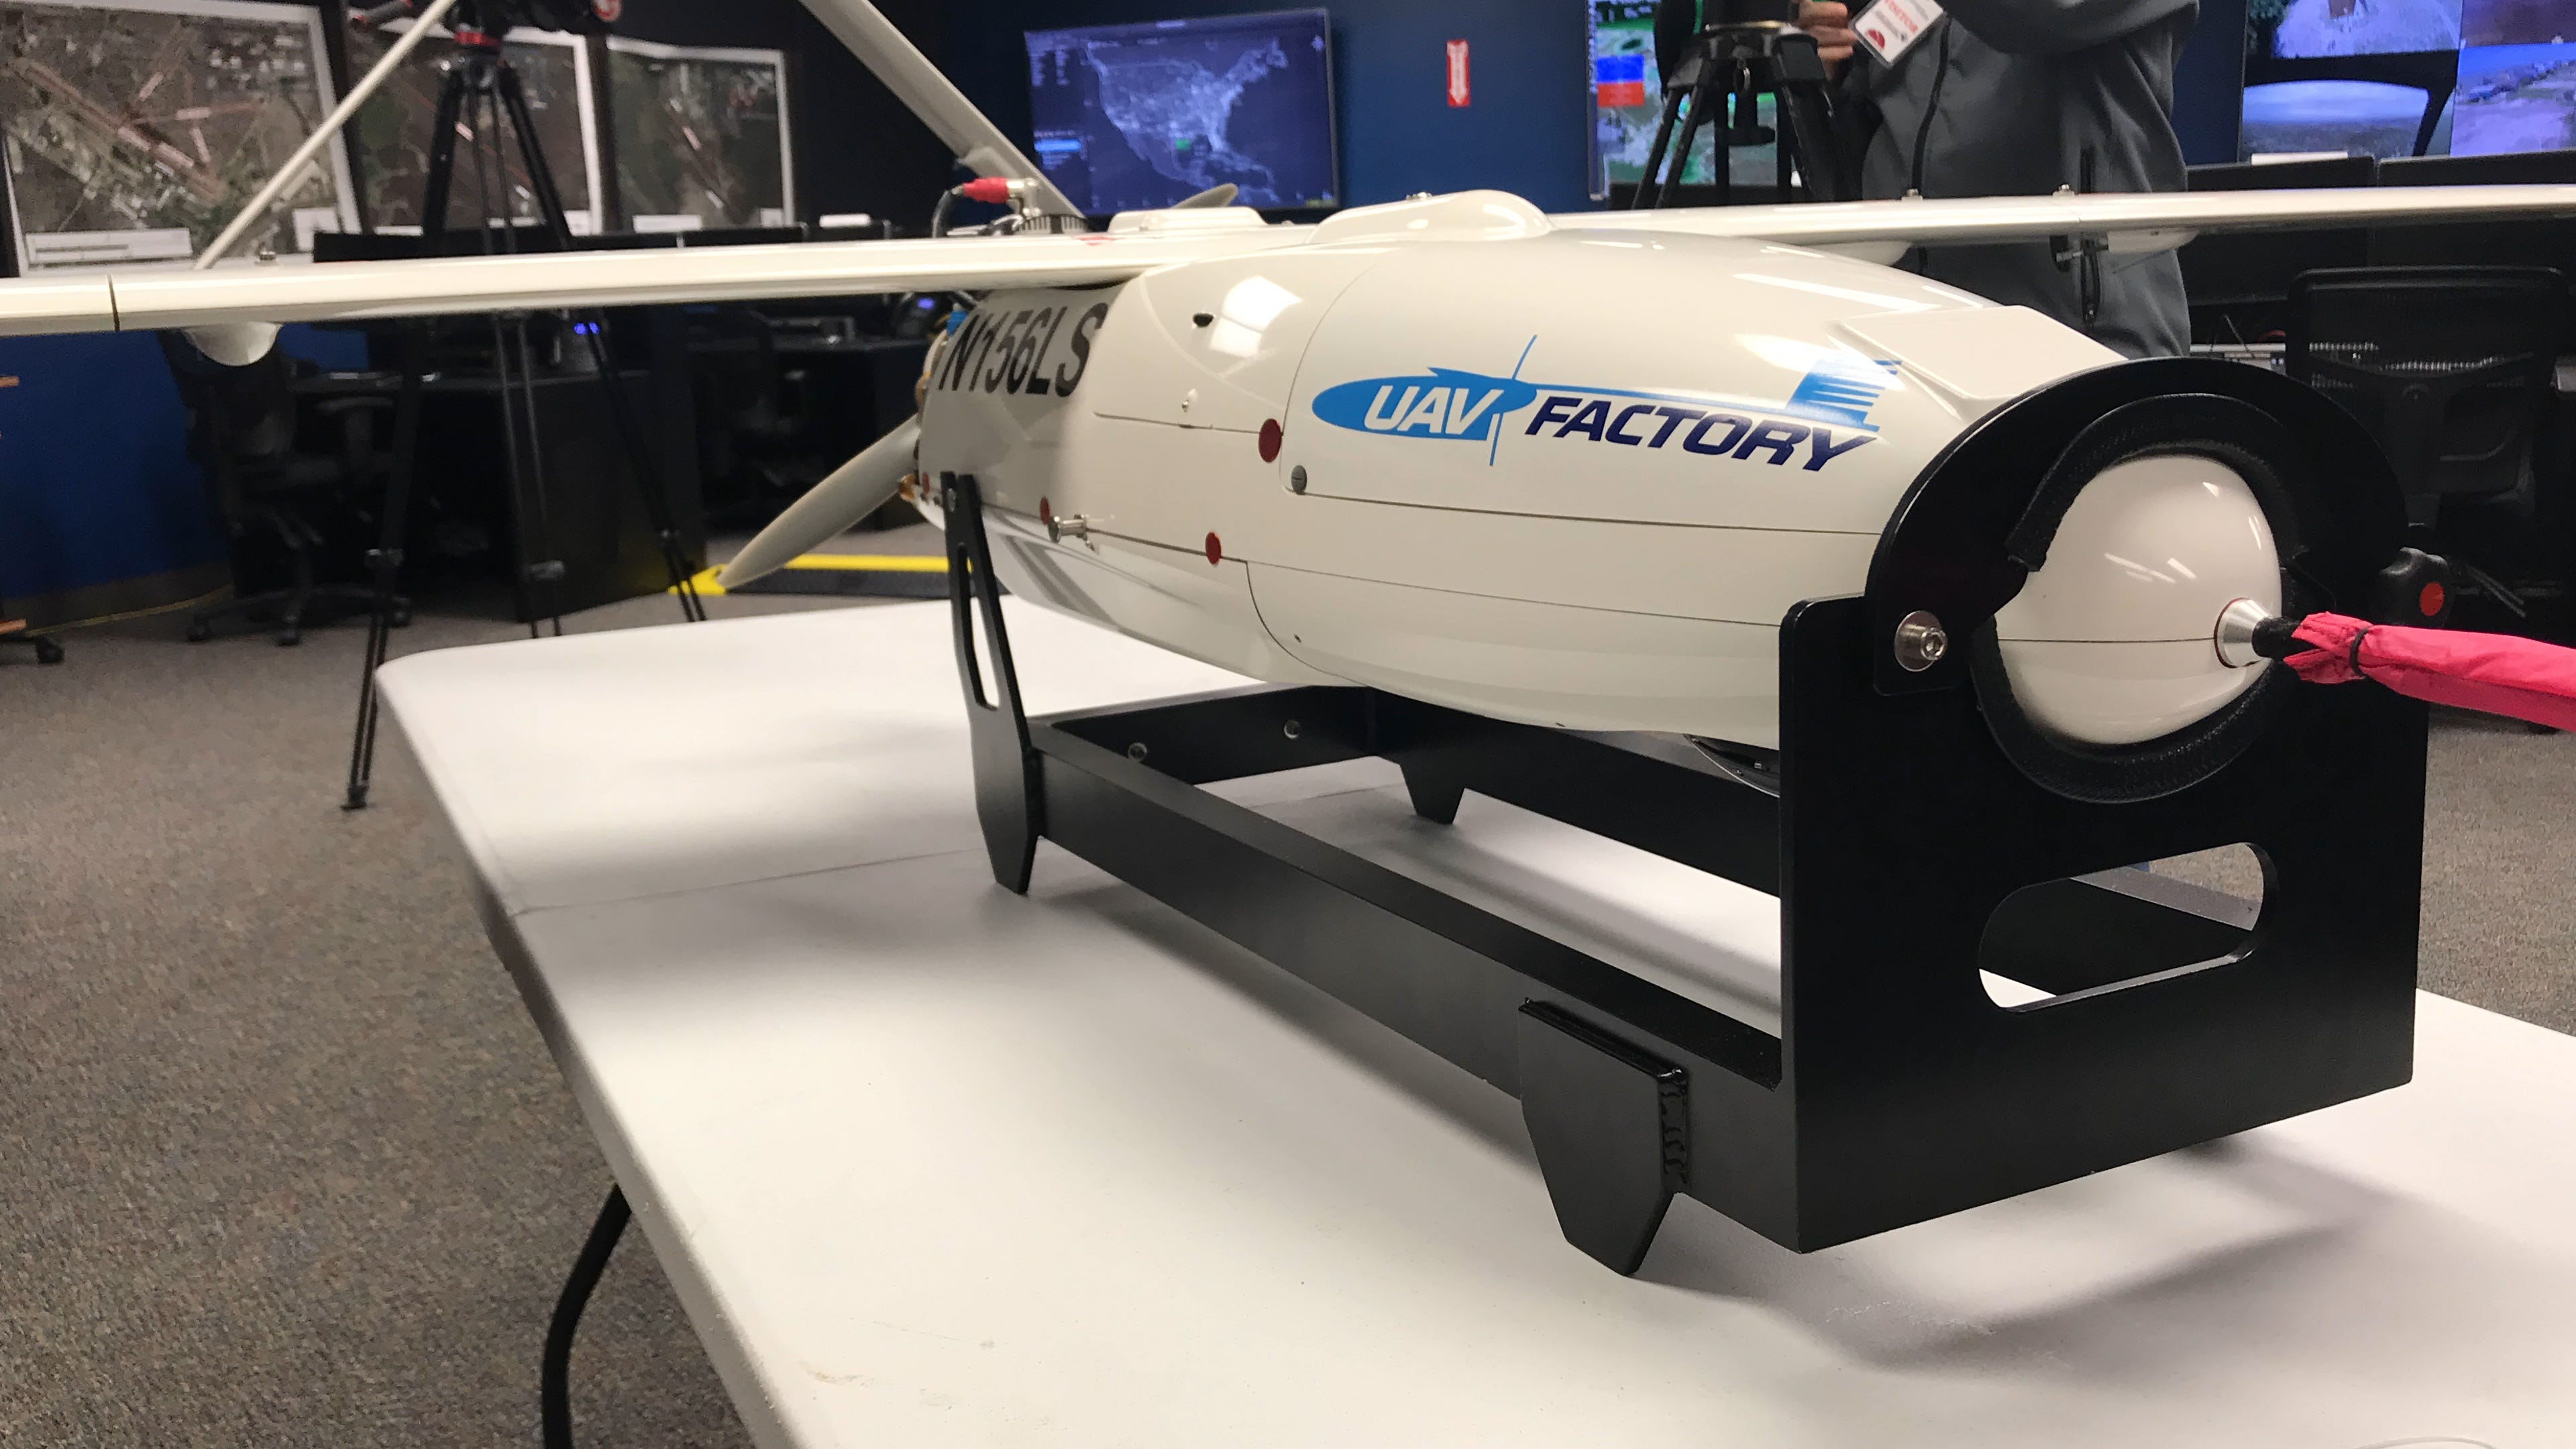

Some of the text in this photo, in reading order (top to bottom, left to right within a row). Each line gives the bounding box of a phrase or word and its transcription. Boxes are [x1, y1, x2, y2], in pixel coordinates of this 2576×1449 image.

[938, 303, 1109, 397] N156LS
[1364, 384, 1877, 472] UAV FACTORY
